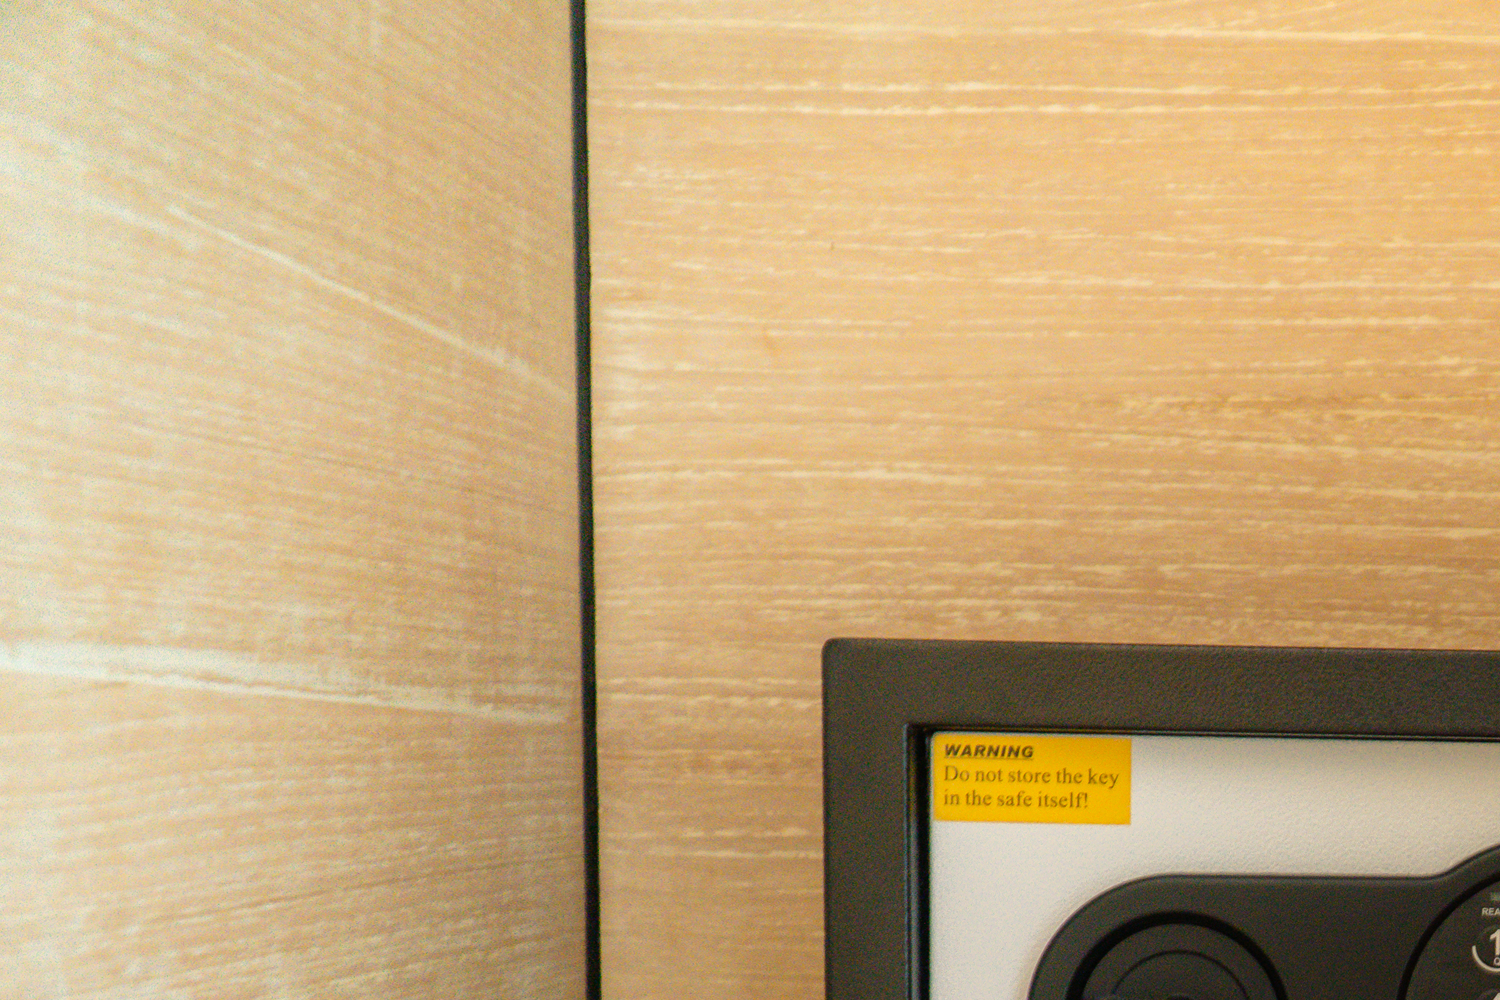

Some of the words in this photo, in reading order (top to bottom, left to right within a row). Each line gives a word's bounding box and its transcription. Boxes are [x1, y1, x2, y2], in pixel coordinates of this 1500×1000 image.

[944, 743, 1034, 760] WARNING
[944, 765, 970, 783] Do
[975, 768, 1003, 783] not
[1009, 769, 1051, 784] store
[1056, 768, 1082, 784] the
[1088, 768, 1119, 789] key
[944, 789, 959, 806] in
[965, 789, 992, 806] the
[996, 790, 1032, 807] safe
[1037, 791, 1089, 809] itself!
